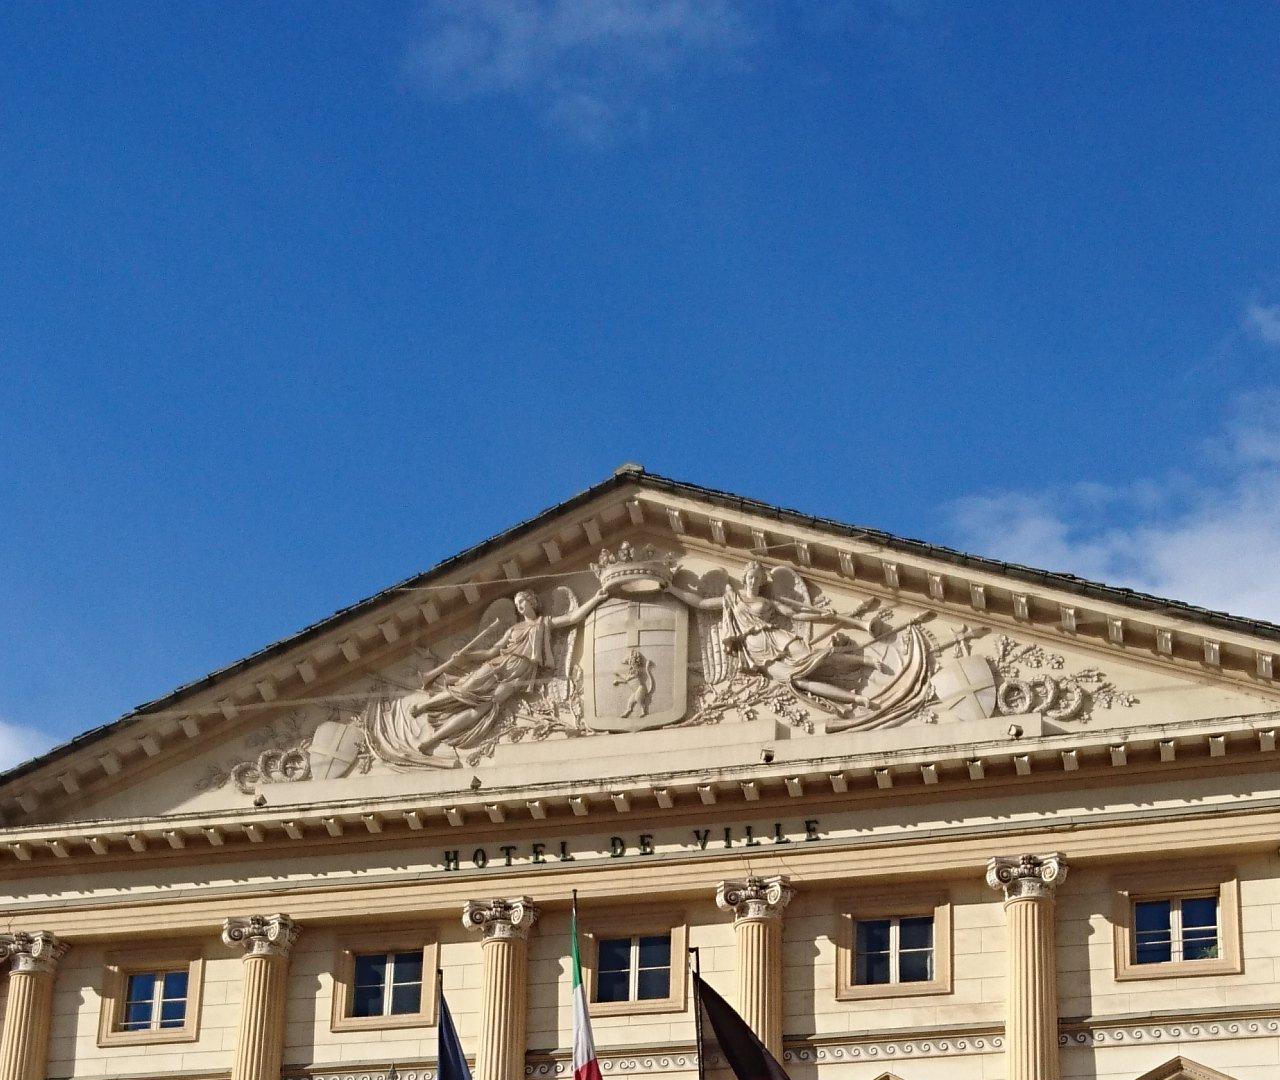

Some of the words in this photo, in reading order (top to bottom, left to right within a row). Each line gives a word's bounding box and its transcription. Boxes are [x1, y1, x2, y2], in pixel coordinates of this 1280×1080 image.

[444, 841, 575, 872] HOTEL
[610, 834, 655, 858] DE
[693, 819, 821, 852] VILLE
